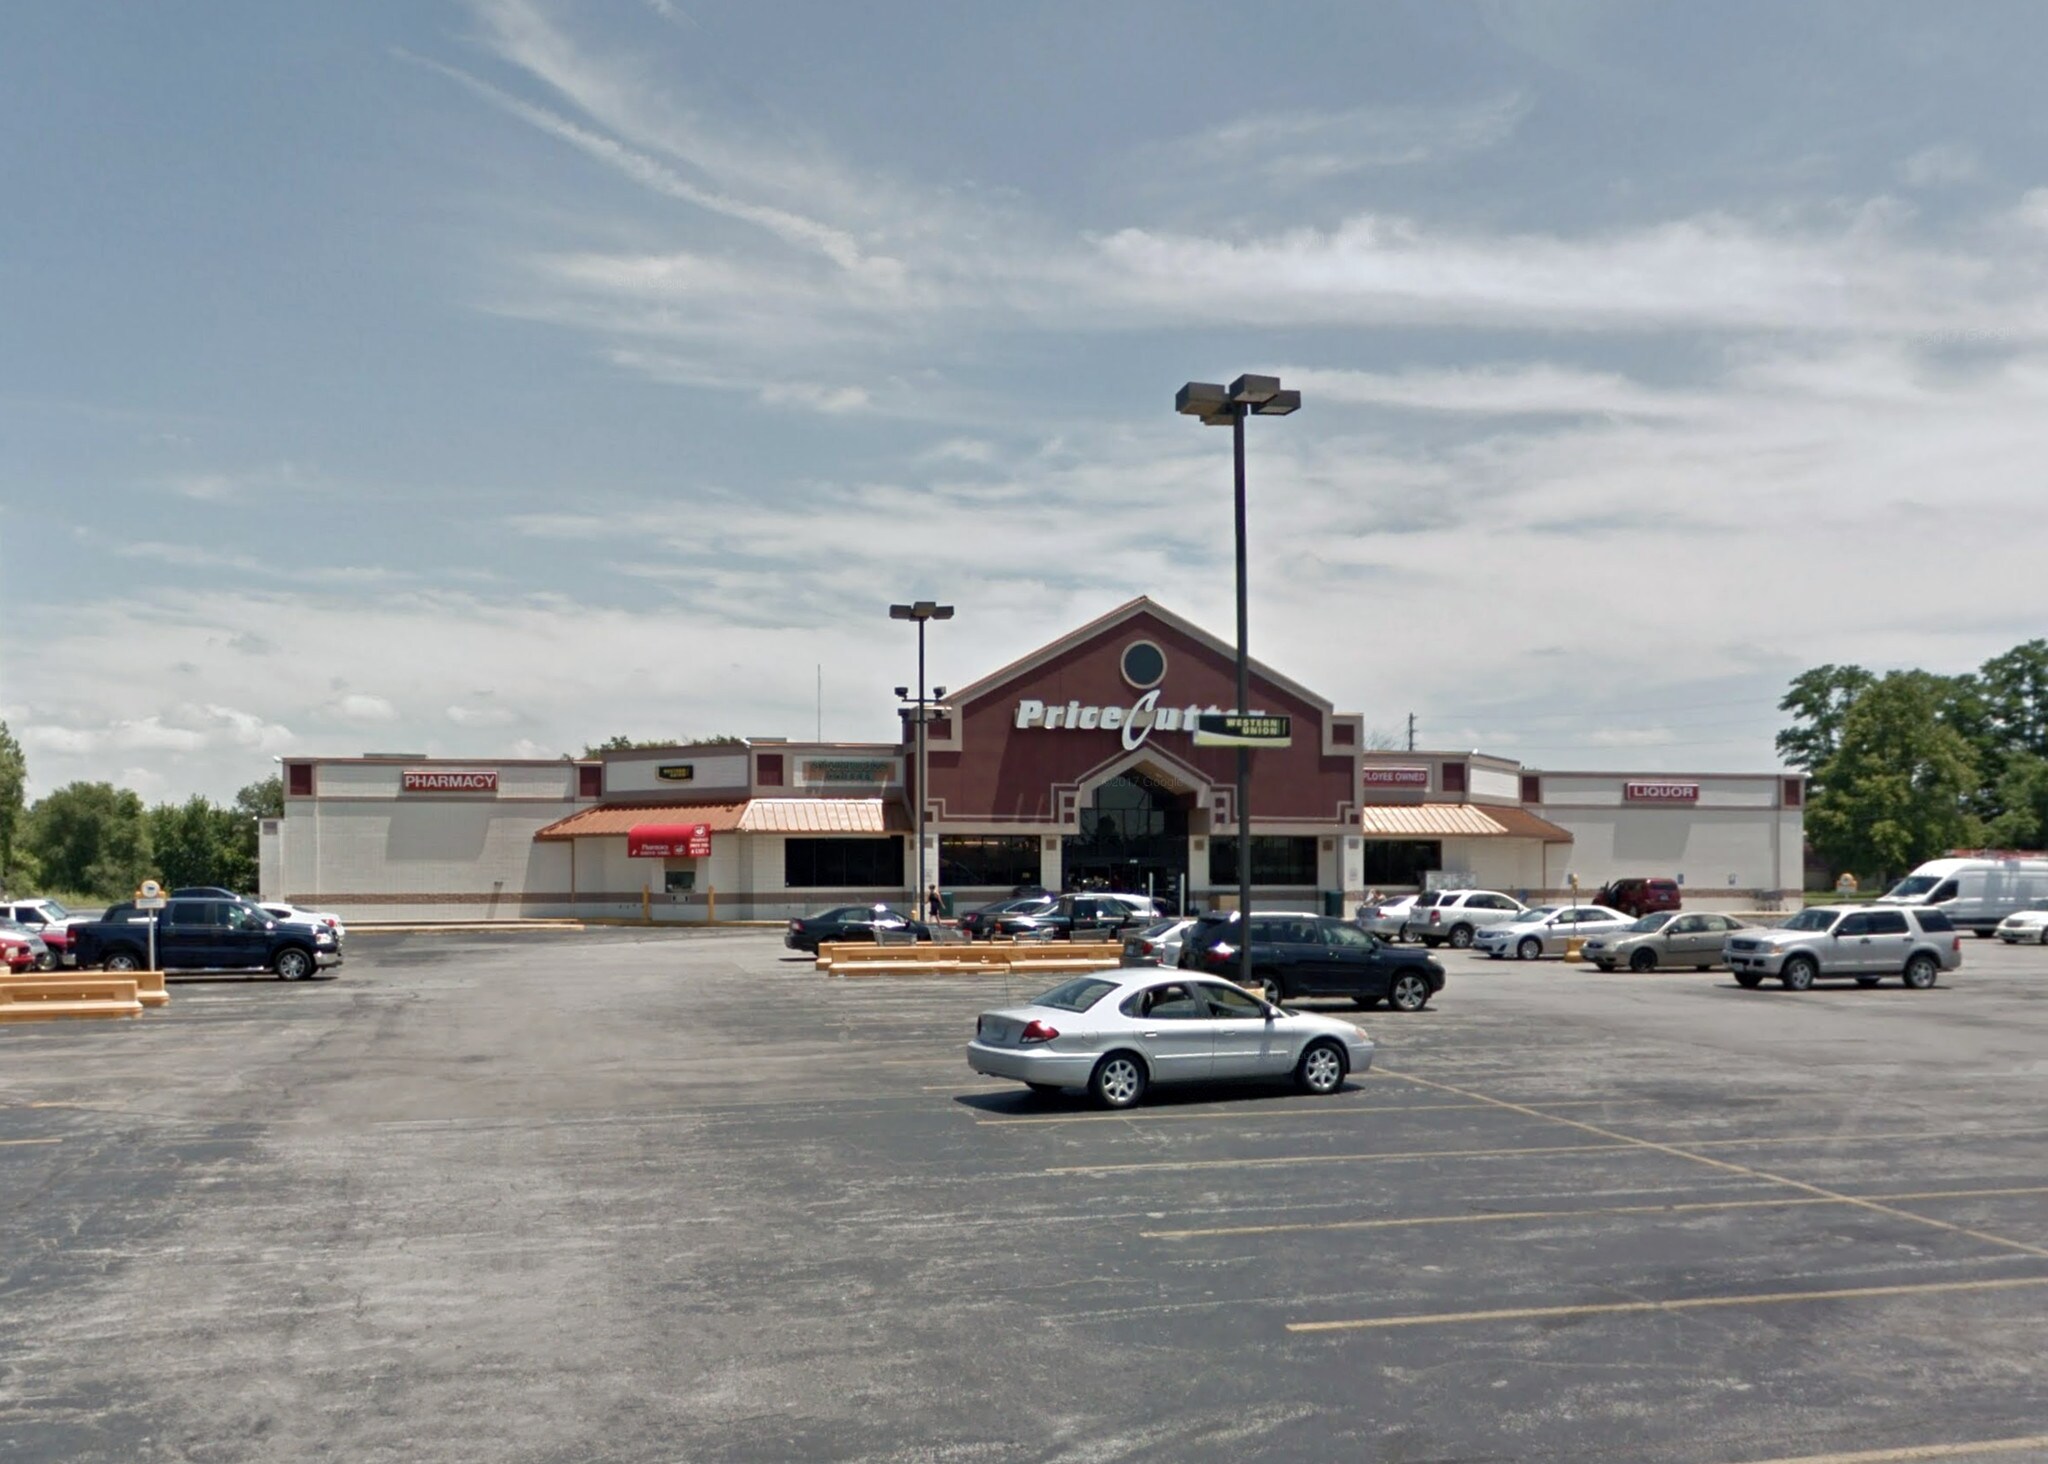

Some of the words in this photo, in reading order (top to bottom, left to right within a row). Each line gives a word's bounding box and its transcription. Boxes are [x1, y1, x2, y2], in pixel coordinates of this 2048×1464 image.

[1121, 690, 1266, 750] Cut
[1226, 718, 1278, 727] WESTERN
[1242, 727, 1278, 735] UNION
[405, 775, 495, 788] PHARMACY
[1363, 772, 1393, 781] PLOYEE
[1394, 772, 1426, 781] OWNED
[1634, 786, 1694, 797] LIQUOR
